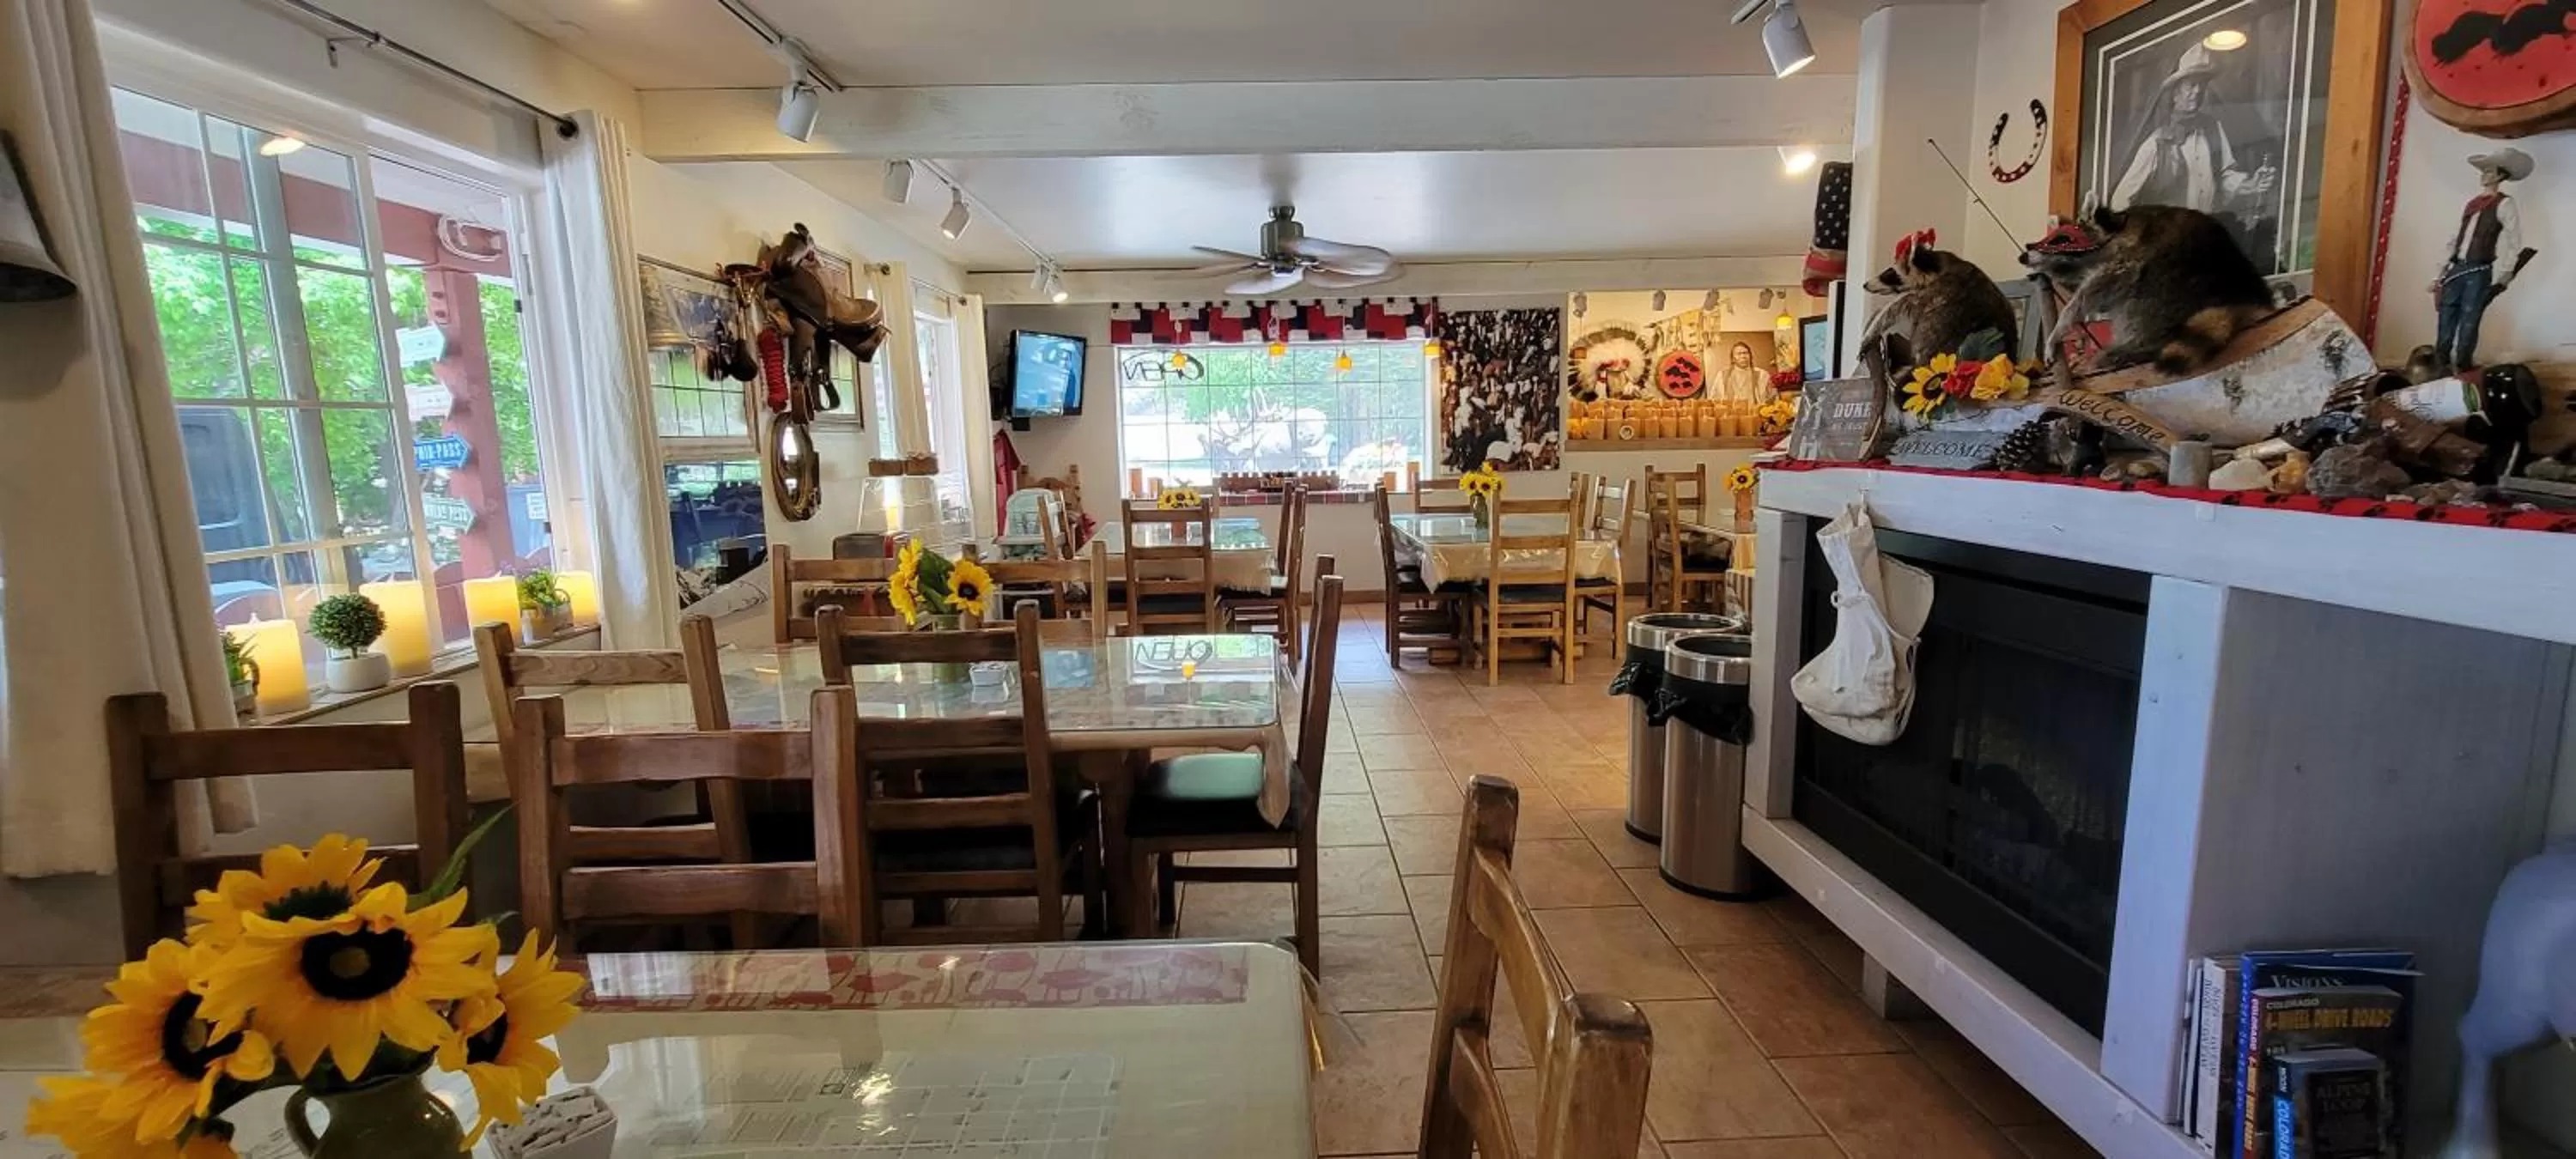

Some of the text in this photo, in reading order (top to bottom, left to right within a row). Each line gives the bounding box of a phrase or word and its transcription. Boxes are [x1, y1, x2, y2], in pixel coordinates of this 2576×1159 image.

[2266, 998, 2320, 1010] COLORADO
[2250, 998, 2259, 1052] COLORADO
[2314, 1008, 2349, 1029] DRIVE
[2352, 1008, 2394, 1028] ROADS
